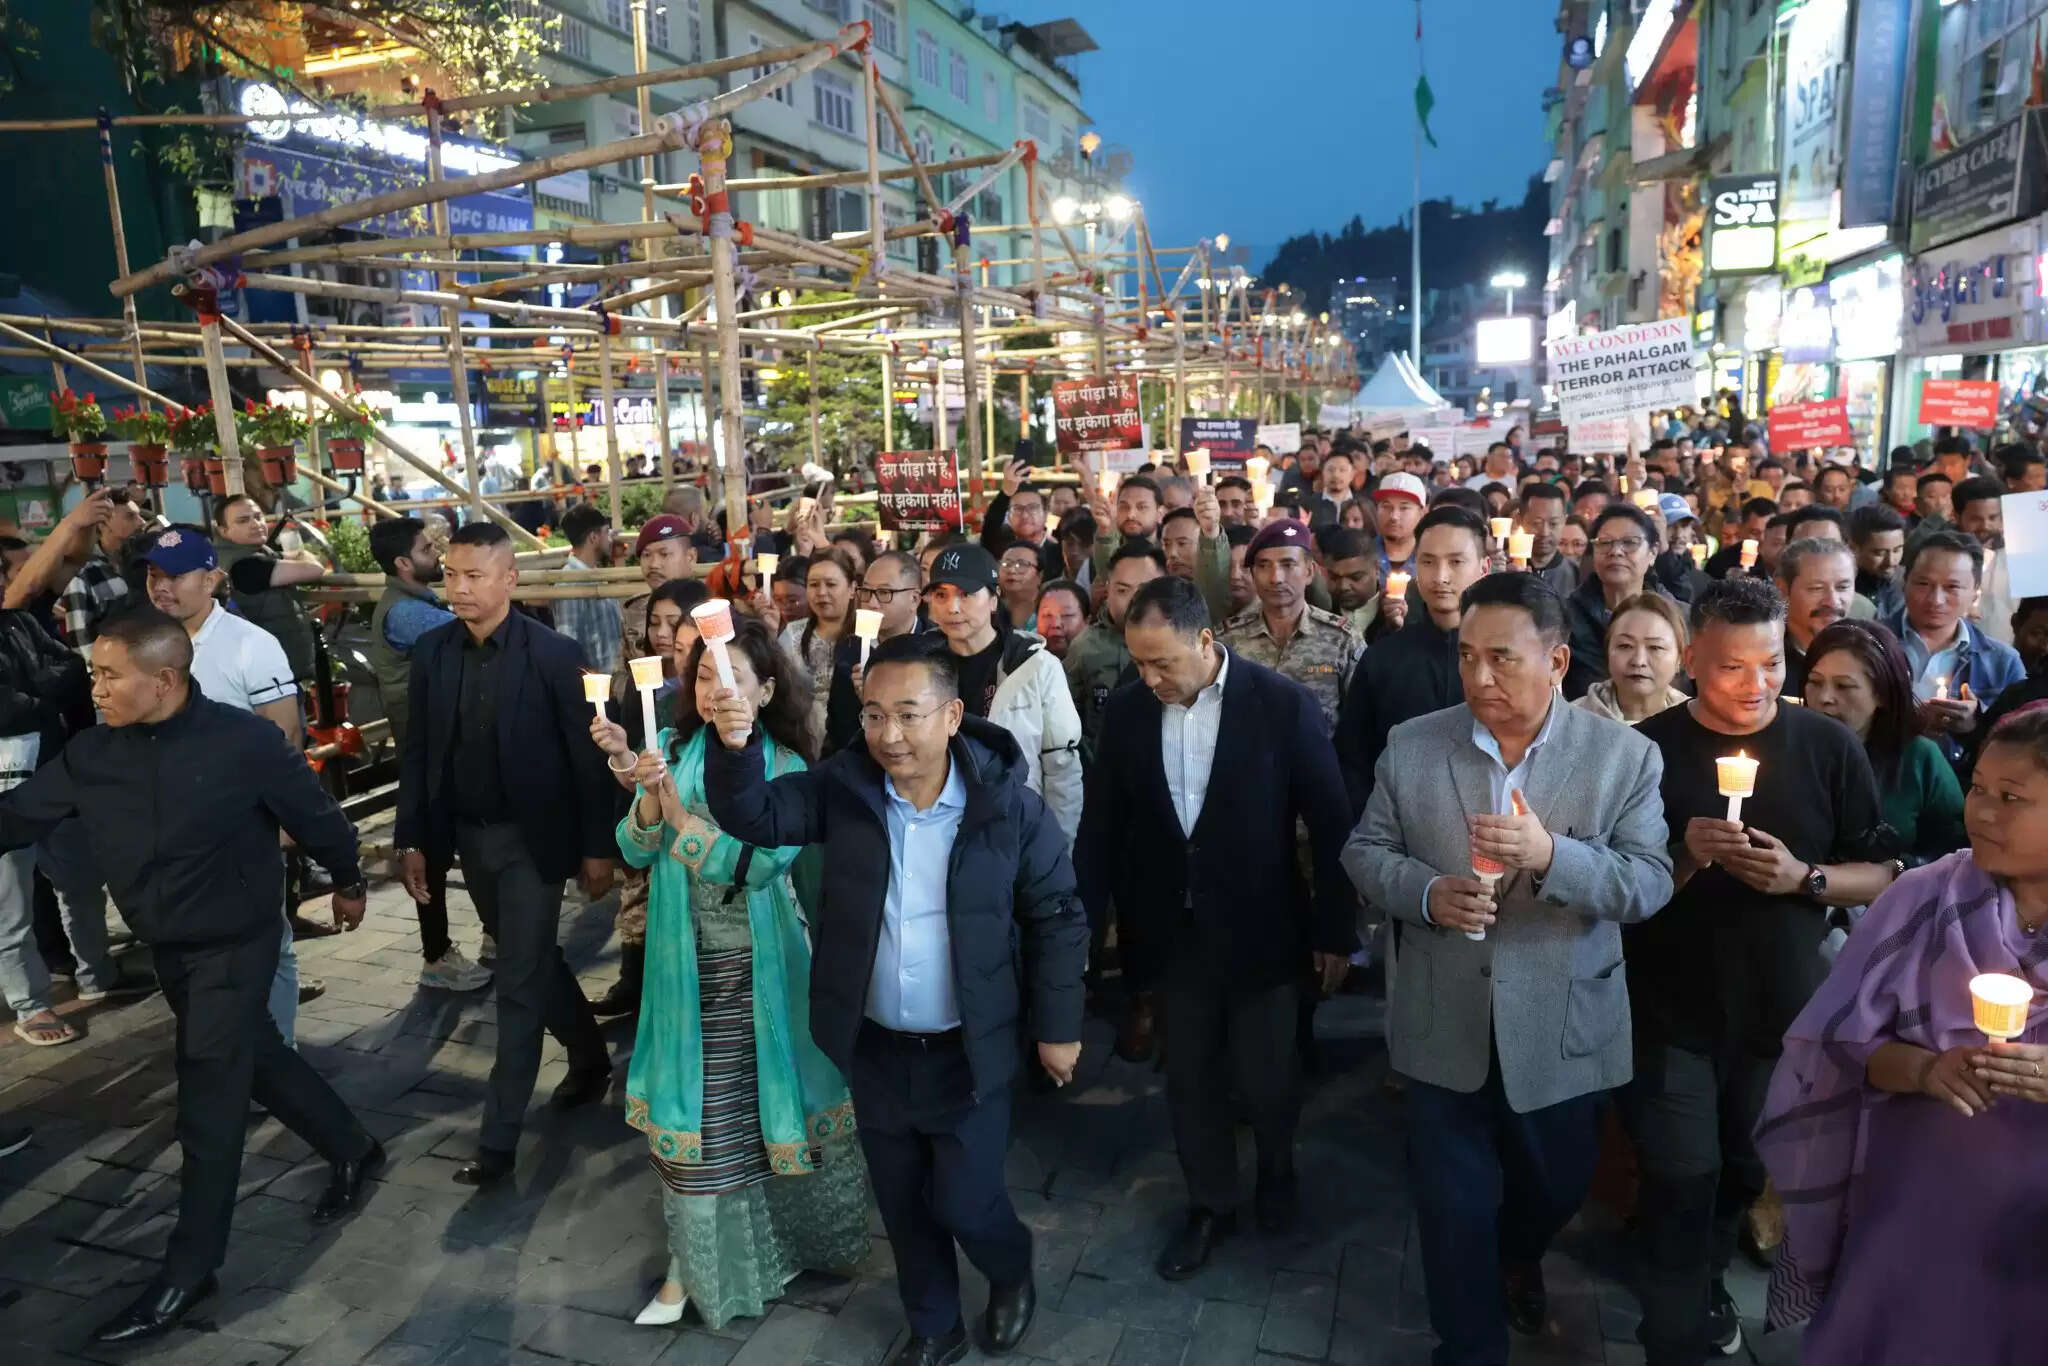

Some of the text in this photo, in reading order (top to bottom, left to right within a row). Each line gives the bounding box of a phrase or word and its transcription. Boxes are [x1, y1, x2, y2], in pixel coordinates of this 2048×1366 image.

[450, 206, 528, 232] DFC BANK
[1714, 191, 1776, 226] SPA
[1554, 323, 1682, 357] WE CONDEMN
[1558, 340, 1687, 375] THE PAHALGAM
[1558, 358, 1692, 392] TERROR ATTACK
[1058, 386, 1077, 405] देश
[1107, 379, 1118, 399] में
[1057, 407, 1139, 438] पर झुकेगा नहीं!
[880, 457, 897, 478] देश
[899, 457, 925, 481] पीड़ा
[926, 456, 937, 477] में
[880, 487, 958, 517] पर झुकेगा नहीं!
